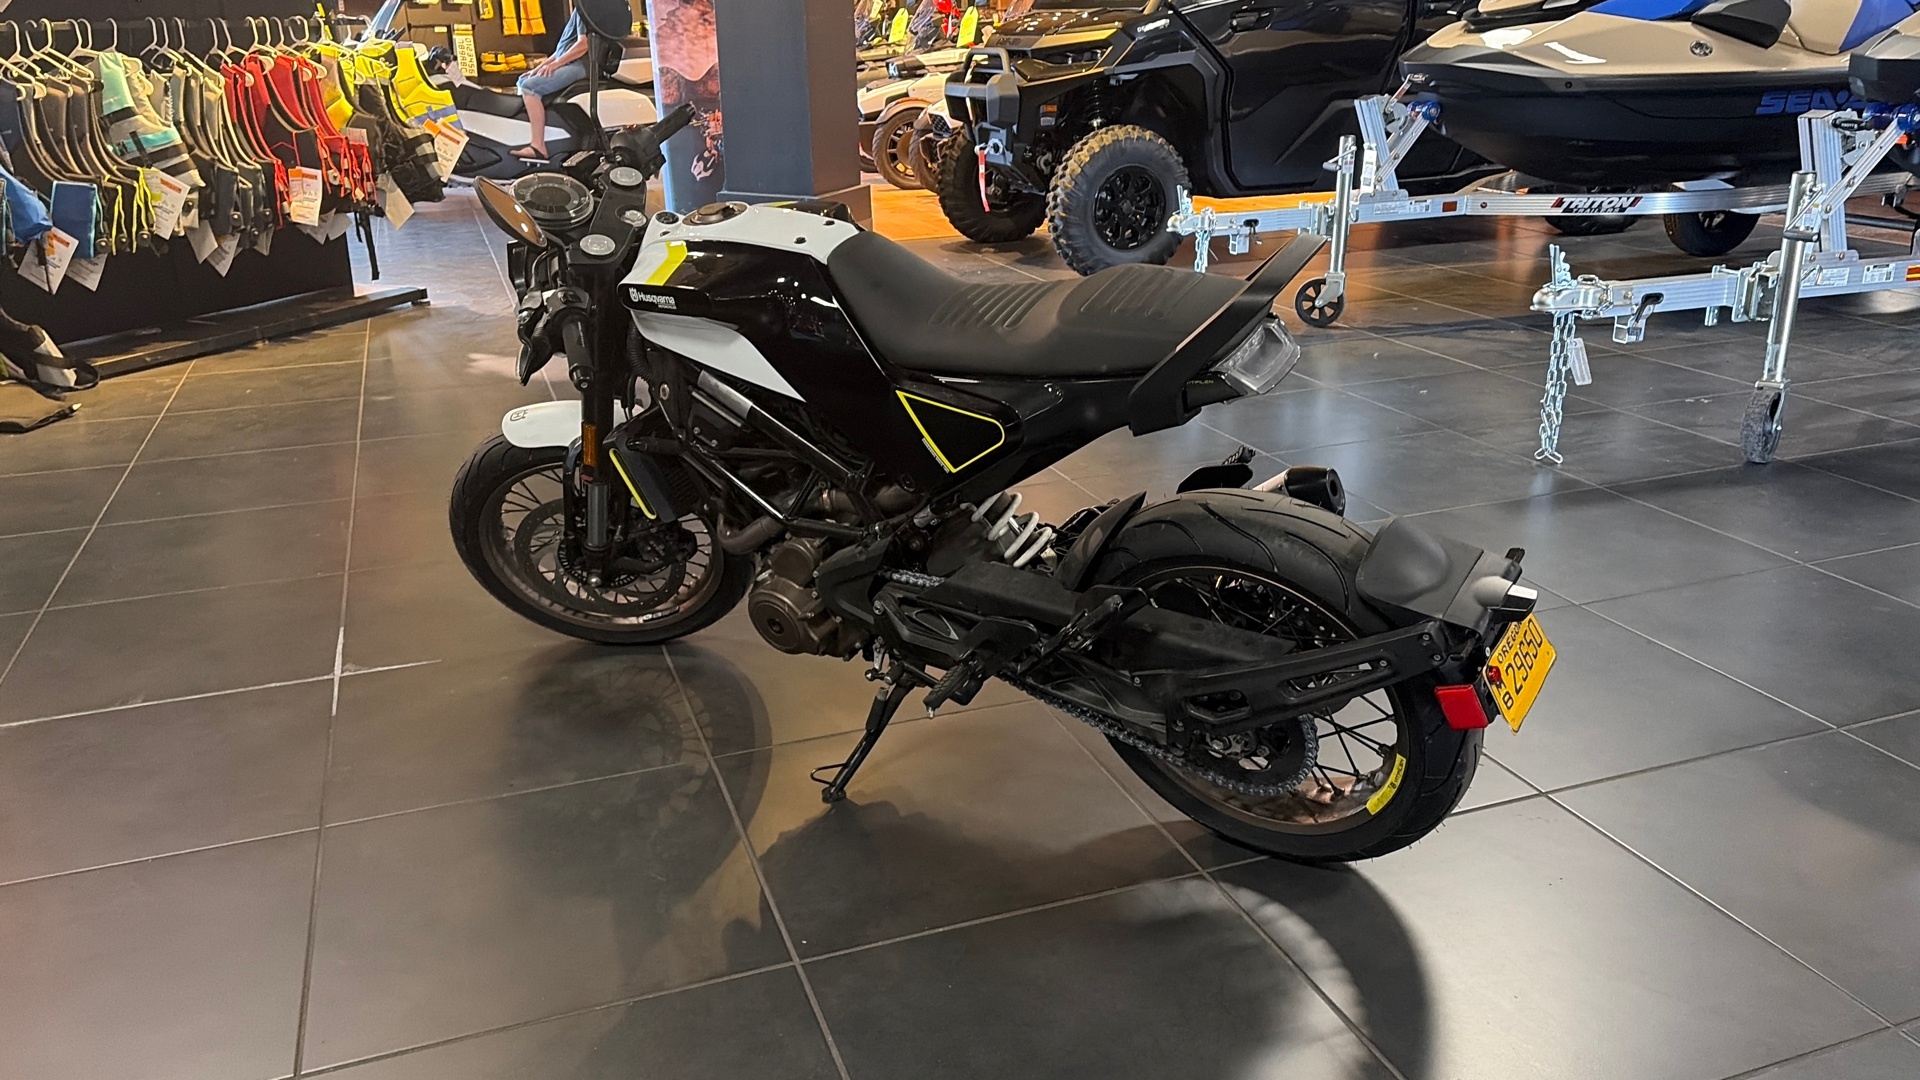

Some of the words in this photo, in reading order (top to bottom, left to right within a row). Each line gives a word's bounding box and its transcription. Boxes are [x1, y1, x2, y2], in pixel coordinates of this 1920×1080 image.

[1560, 197, 1634, 208] TRITON
[638, 291, 676, 304] Husqvarna
[1505, 618, 1543, 695] 29650
